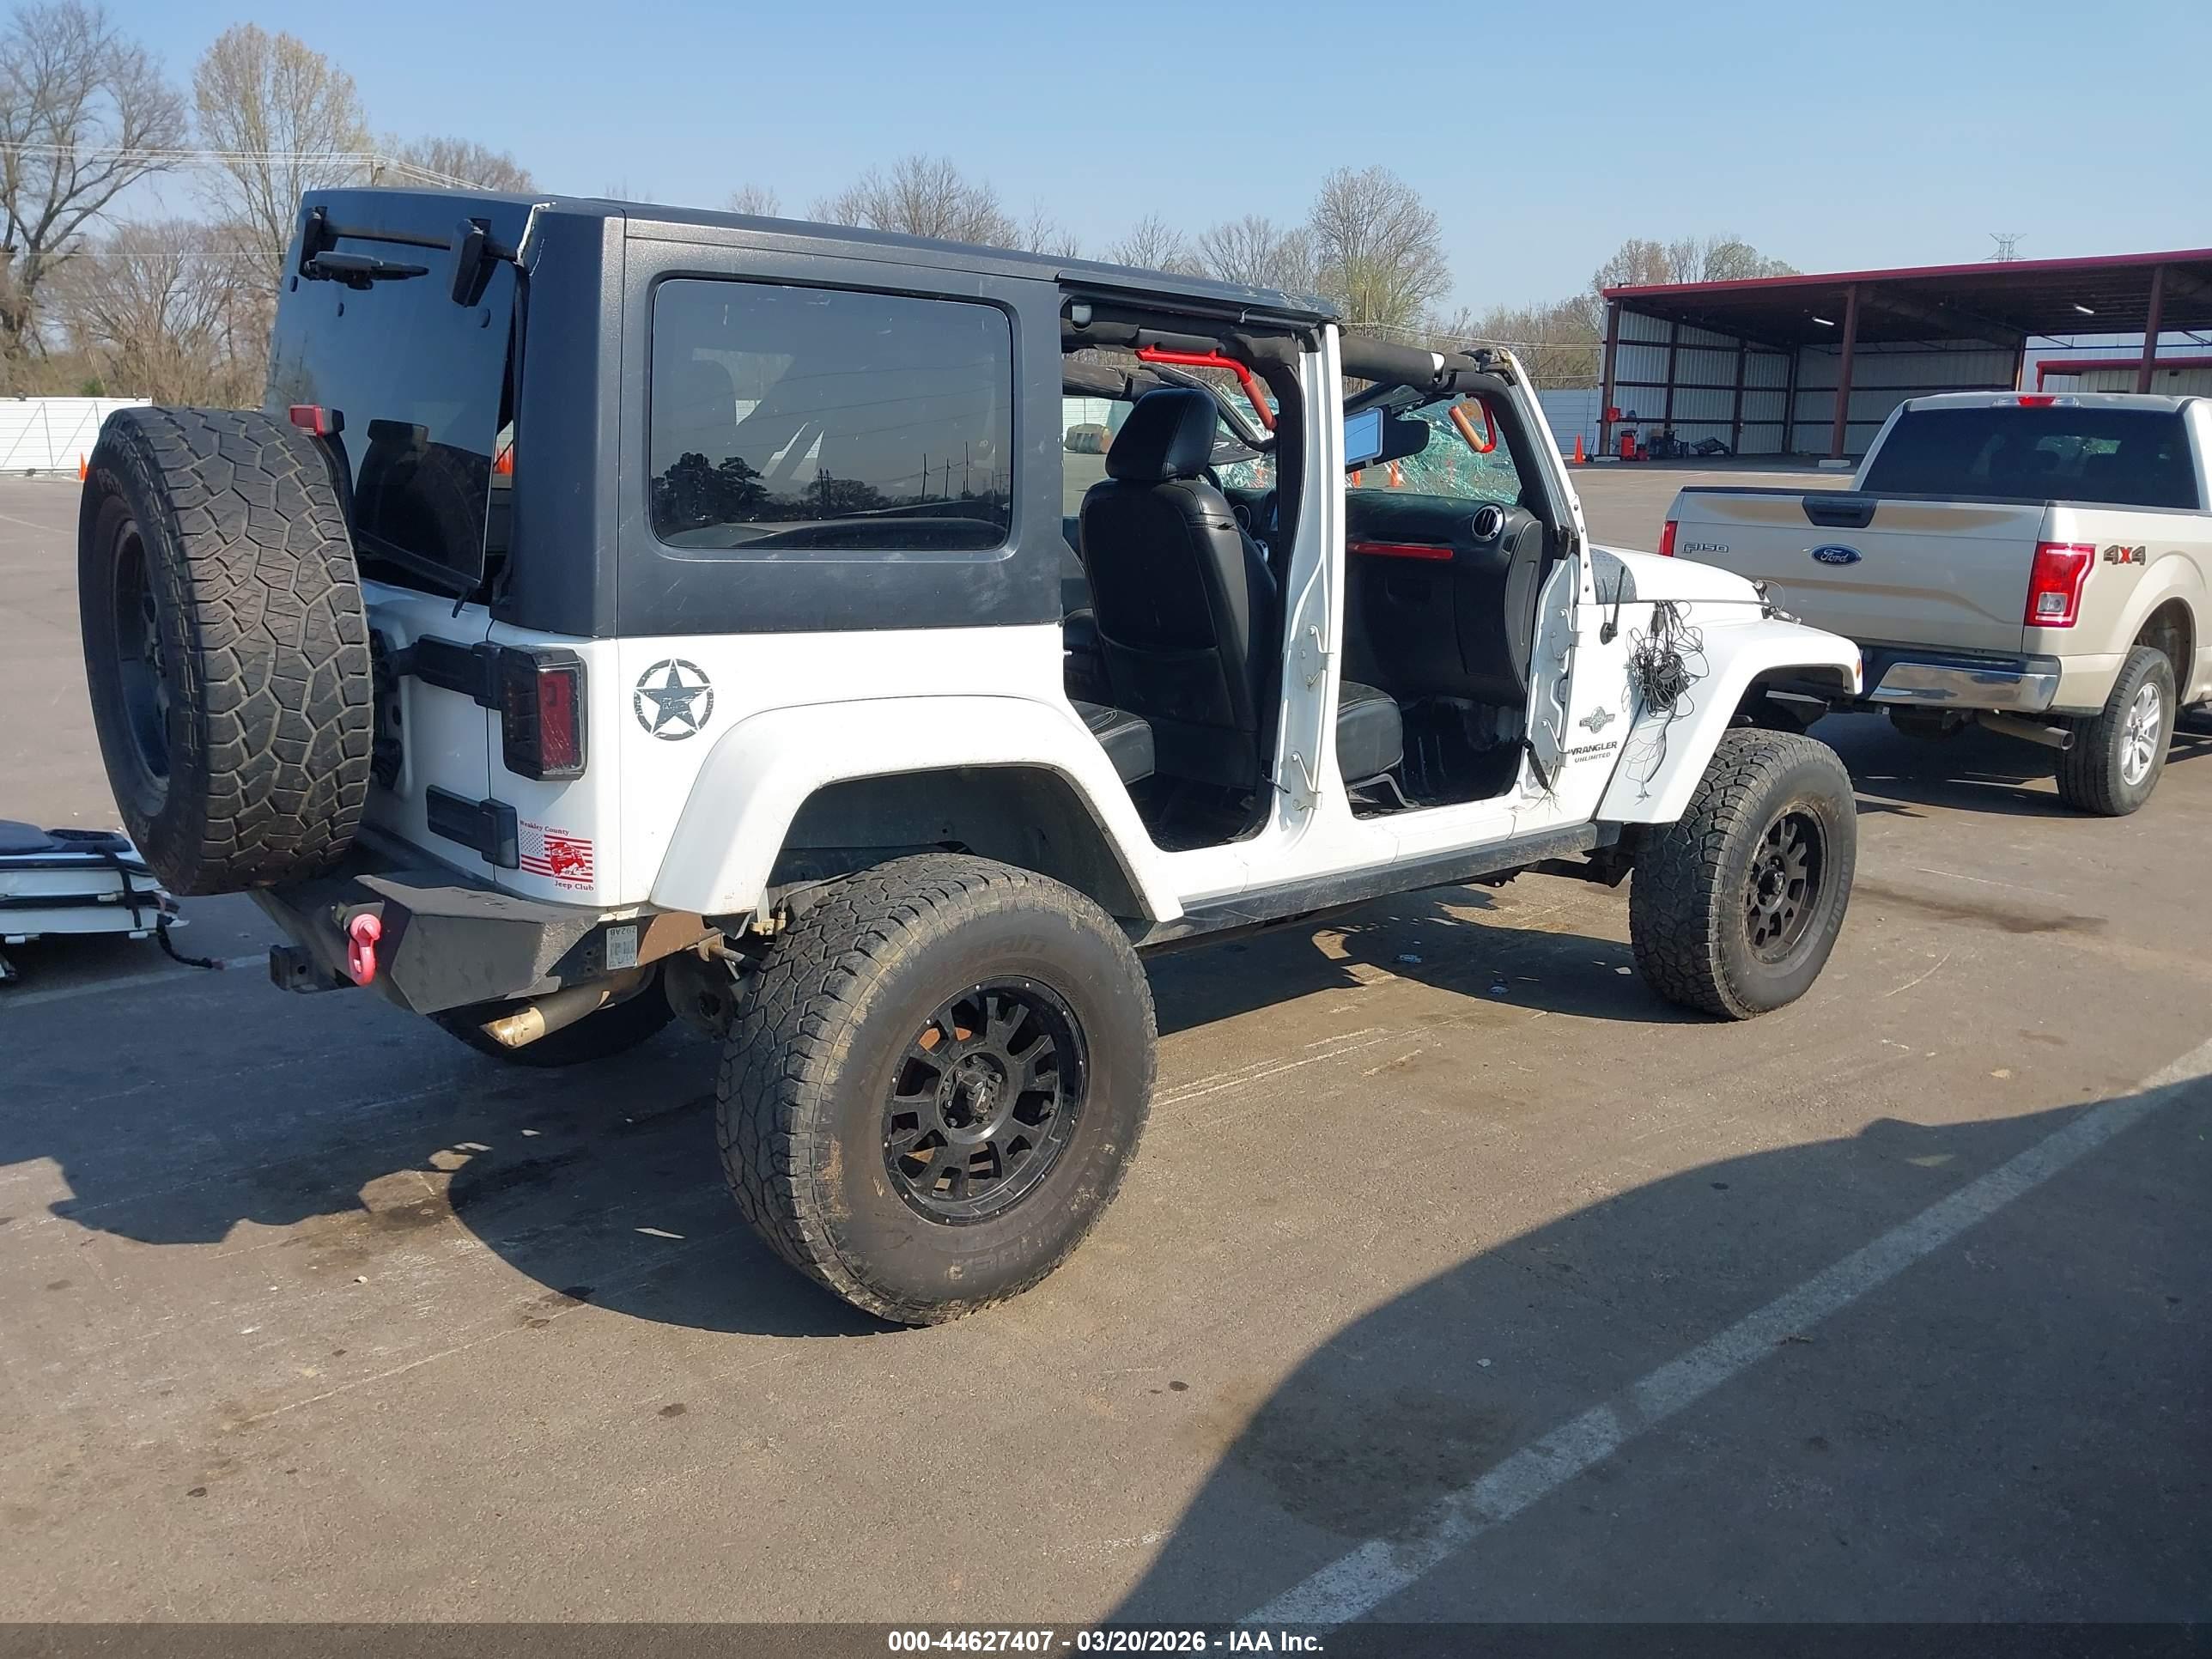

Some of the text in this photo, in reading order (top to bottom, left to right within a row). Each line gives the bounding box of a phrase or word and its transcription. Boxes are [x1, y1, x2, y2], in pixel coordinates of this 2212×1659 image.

[1820, 549, 1849, 563] Ford
[1568, 741, 1618, 755] WRANGLER
[1574, 752, 1611, 763] UNLIMITED
[520, 820, 569, 836] Weakley County
[555, 880, 594, 891] Jeep Club
